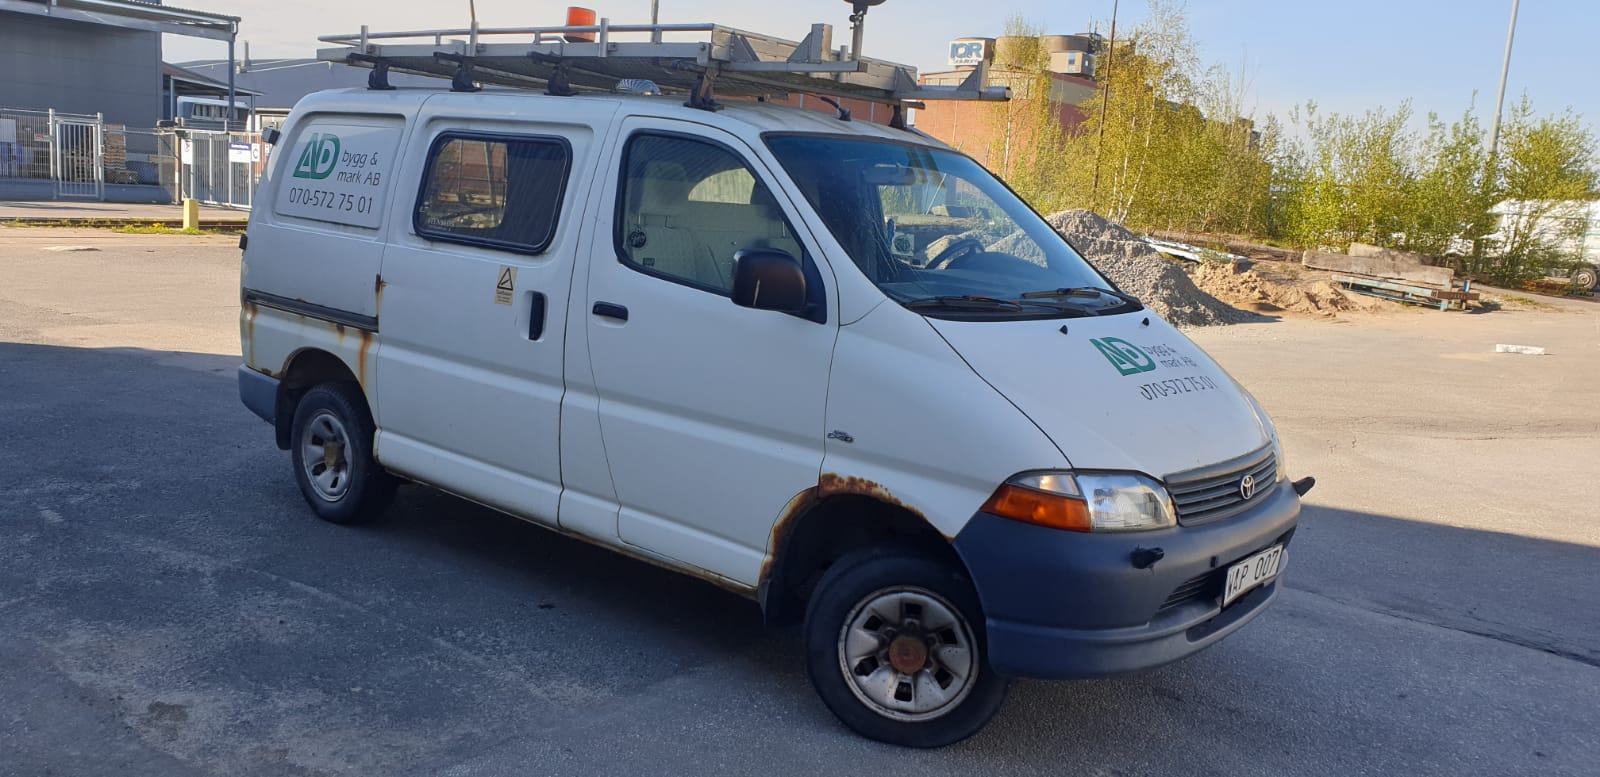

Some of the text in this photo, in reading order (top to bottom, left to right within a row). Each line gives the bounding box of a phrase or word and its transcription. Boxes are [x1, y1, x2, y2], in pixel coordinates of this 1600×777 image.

[342, 150, 379, 168] bygg &
[337, 171, 381, 186] mark AB
[289, 187, 373, 214] 070-572 75 01
[1138, 376, 1218, 400] 070-572 75 01
[1226, 550, 1280, 598] WAP 007
